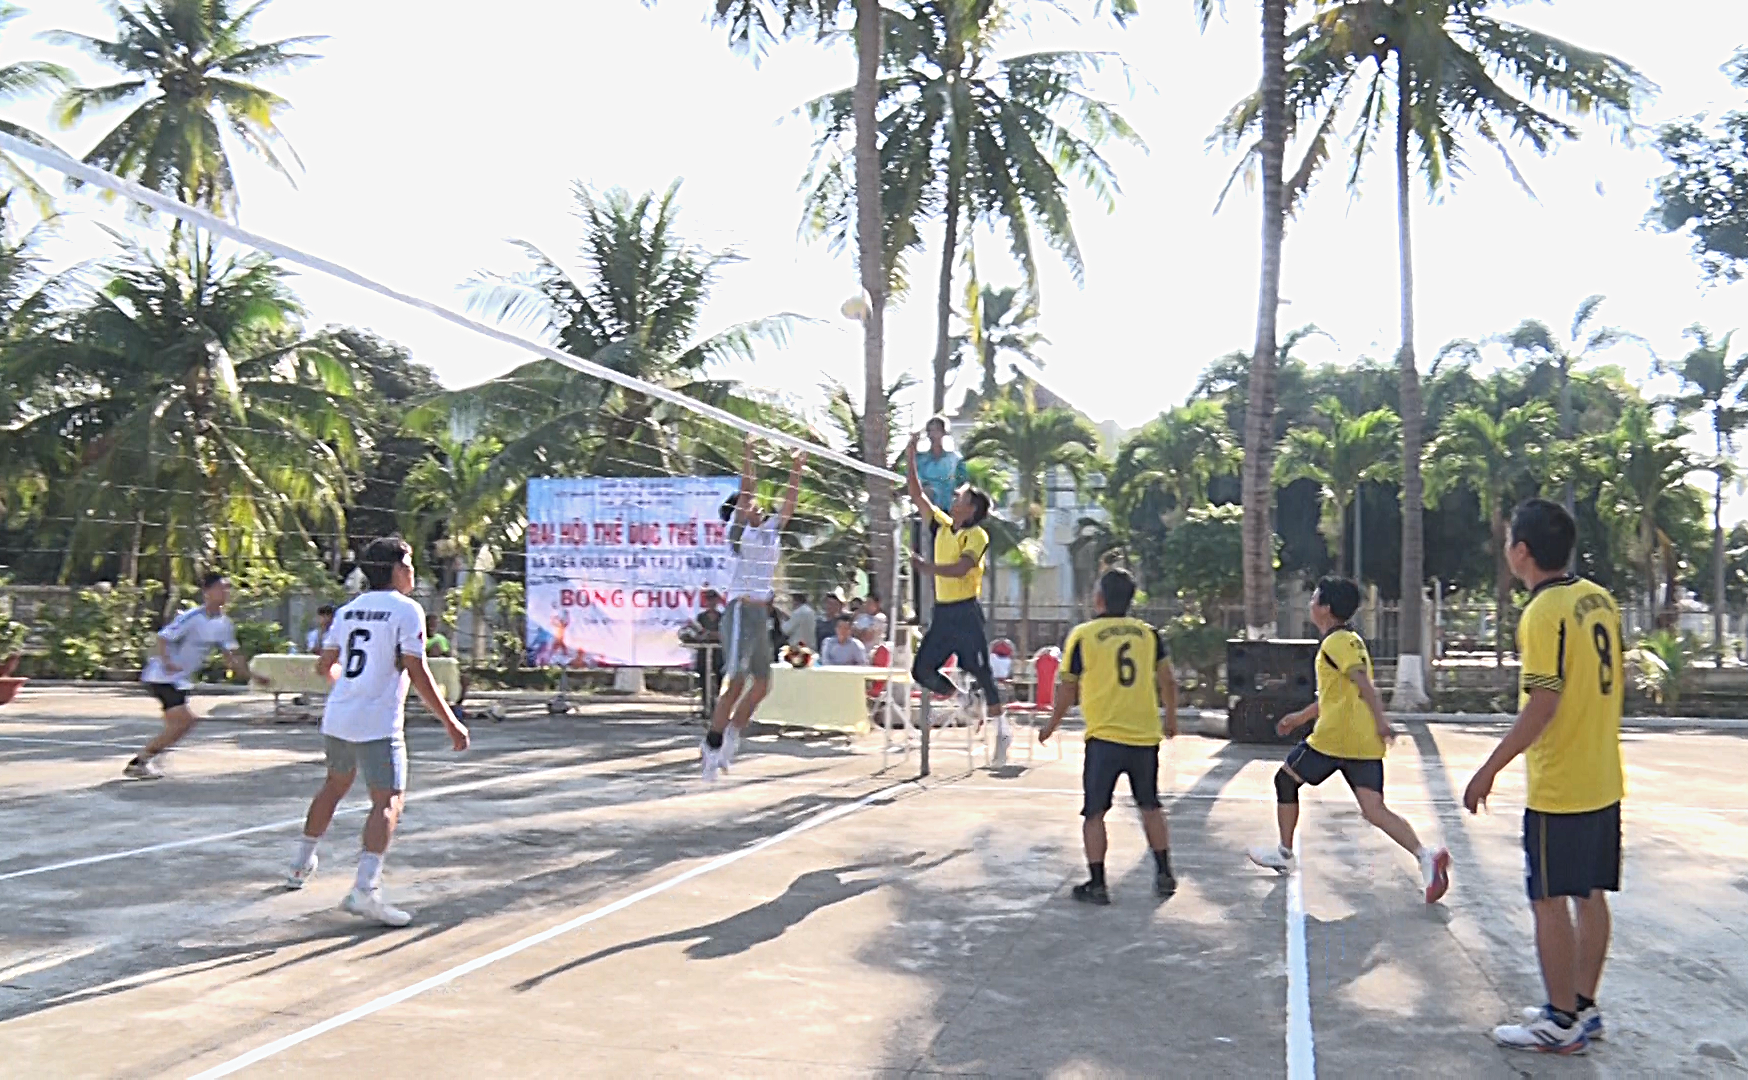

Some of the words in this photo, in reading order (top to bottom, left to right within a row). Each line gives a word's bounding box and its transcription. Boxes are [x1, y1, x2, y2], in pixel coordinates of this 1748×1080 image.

[345, 628, 371, 679] 6
[1117, 641, 1136, 688] 6
[1593, 621, 1612, 695] 8
